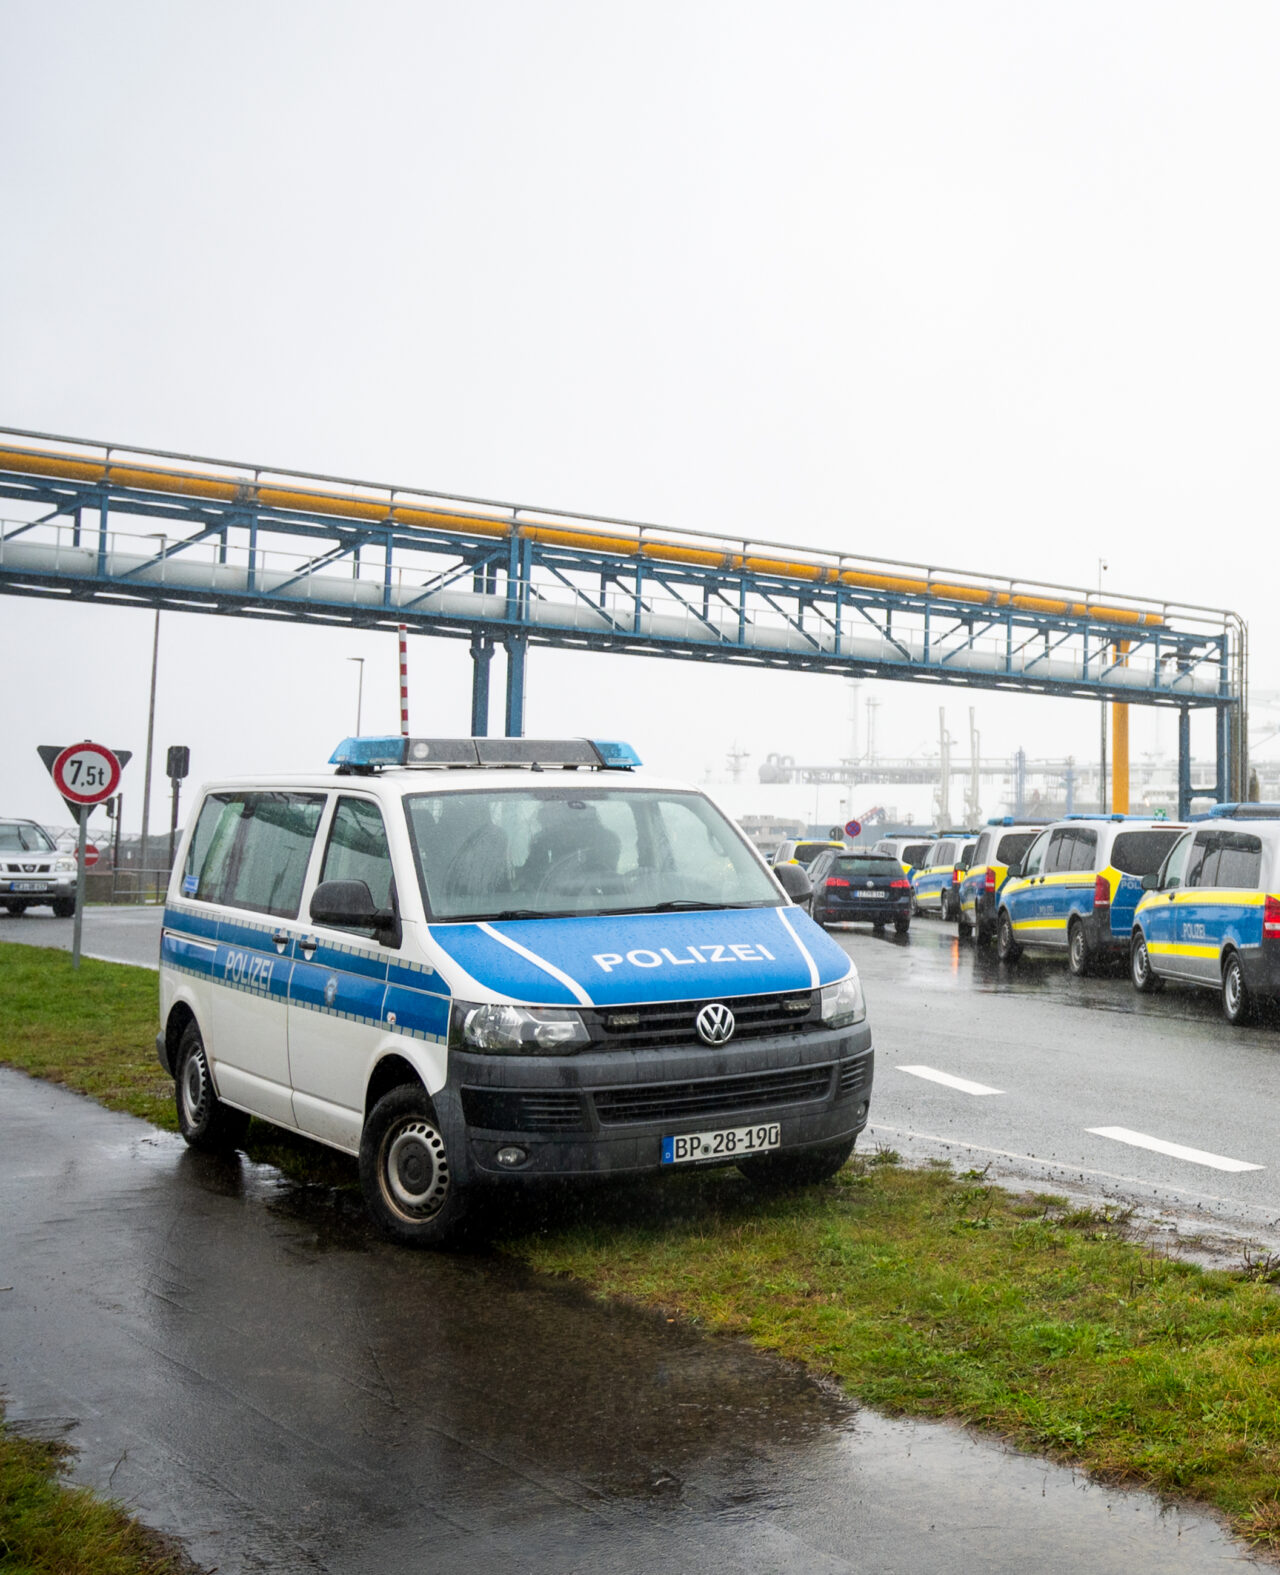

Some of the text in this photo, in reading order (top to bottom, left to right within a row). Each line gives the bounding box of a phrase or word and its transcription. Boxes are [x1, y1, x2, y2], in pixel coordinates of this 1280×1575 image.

[70, 759, 104, 787] 7,5t
[224, 951, 275, 992] POLIZEI
[592, 943, 776, 973] POLIZEI
[675, 1136, 701, 1159] BP
[713, 1125, 779, 1154] 28-190
